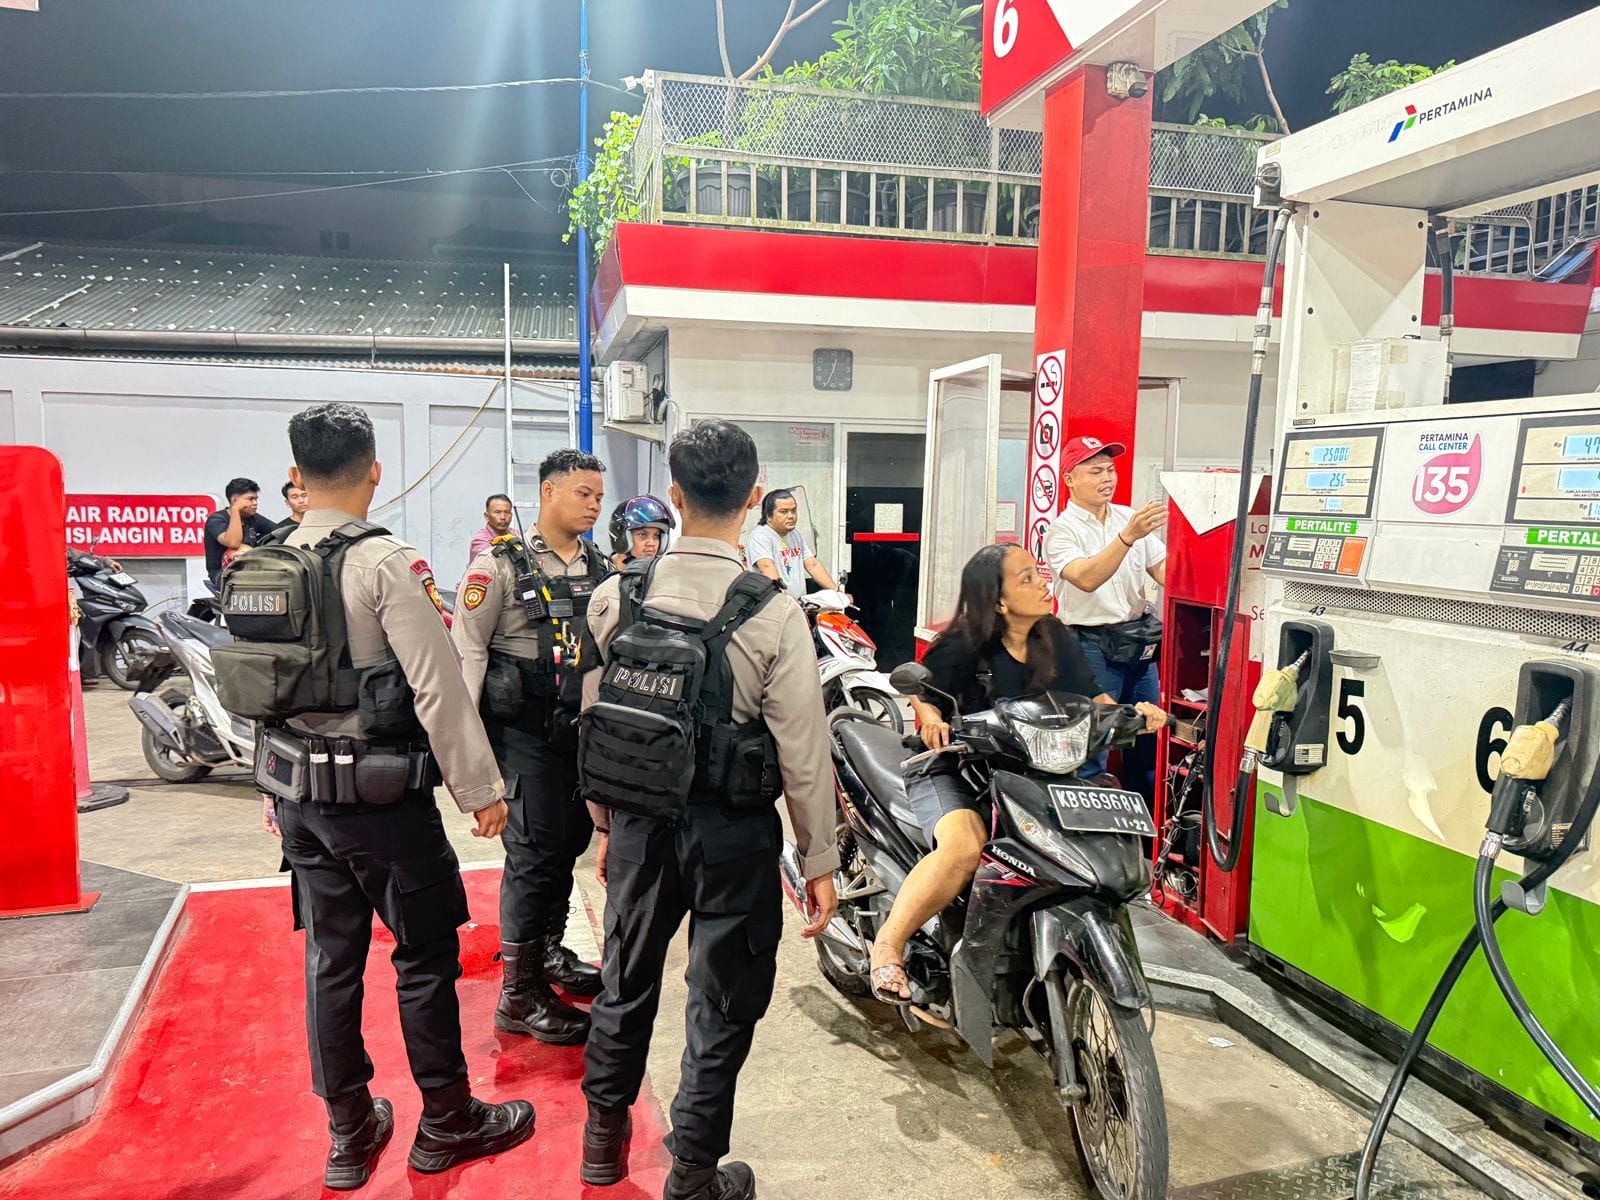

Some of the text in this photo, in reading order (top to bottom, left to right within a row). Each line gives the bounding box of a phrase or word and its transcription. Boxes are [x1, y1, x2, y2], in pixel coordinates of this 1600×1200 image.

[993, 0, 1018, 58] 6
[1418, 87, 1493, 125] PERTAMINA
[1420, 433, 1469, 442] PERTAMINA
[1418, 442, 1468, 451] CALL CENTER
[1414, 466, 1470, 504] 135
[66, 506, 208, 523] AIR RADIATOR
[1294, 519, 1352, 533] PERTALITE
[66, 527, 91, 544] ISI
[99, 527, 163, 544] ANGIN
[230, 594, 280, 611] POLISI
[1309, 605, 1326, 616] 43
[1561, 641, 1589, 655] 44
[613, 667, 677, 696] POLISI
[1336, 678, 1365, 756] 5
[1476, 707, 1514, 795] 6
[992, 844, 1037, 878] HONDA
